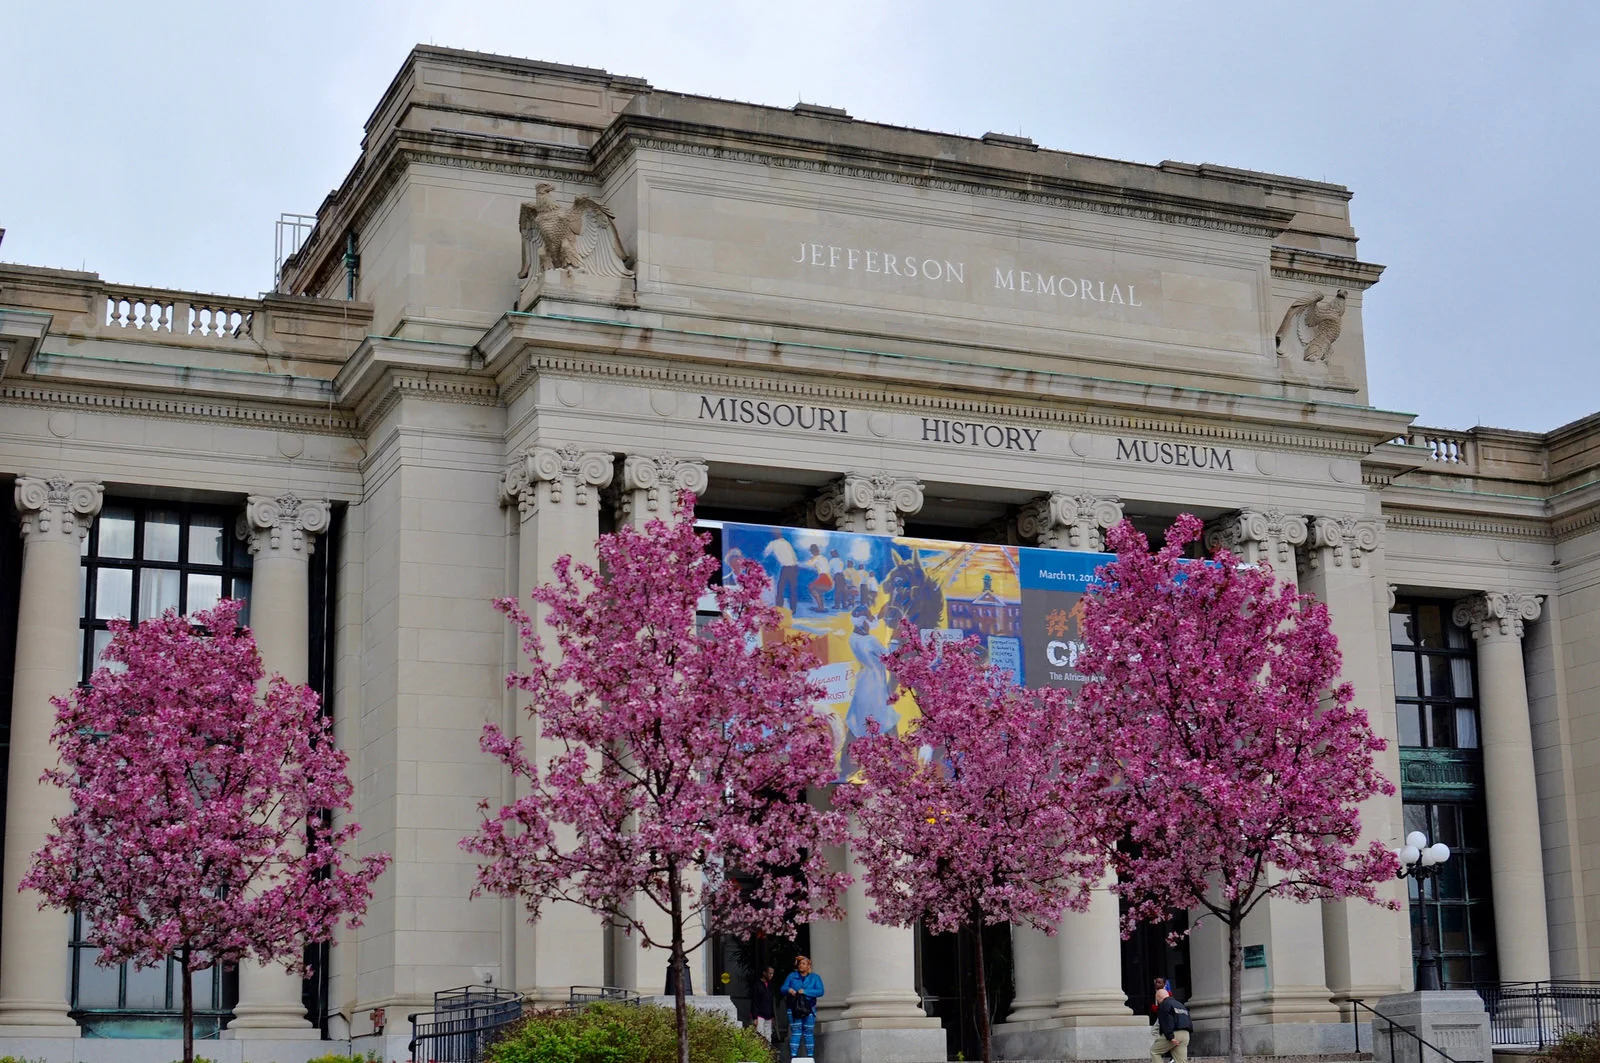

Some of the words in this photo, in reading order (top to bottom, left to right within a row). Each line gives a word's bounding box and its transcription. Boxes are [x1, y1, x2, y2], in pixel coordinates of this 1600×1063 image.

[792, 242, 965, 283] JEFFERSON
[994, 266, 1143, 307] MEMORIAL
[698, 395, 848, 433] MISSOURI
[921, 418, 1042, 451] HISTORY
[1116, 438, 1234, 471] MUSEUM
[1039, 569, 1066, 580] March
[1067, 573, 1078, 582] 11,
[1049, 671, 1062, 681] The
[1064, 672, 1090, 682] African
